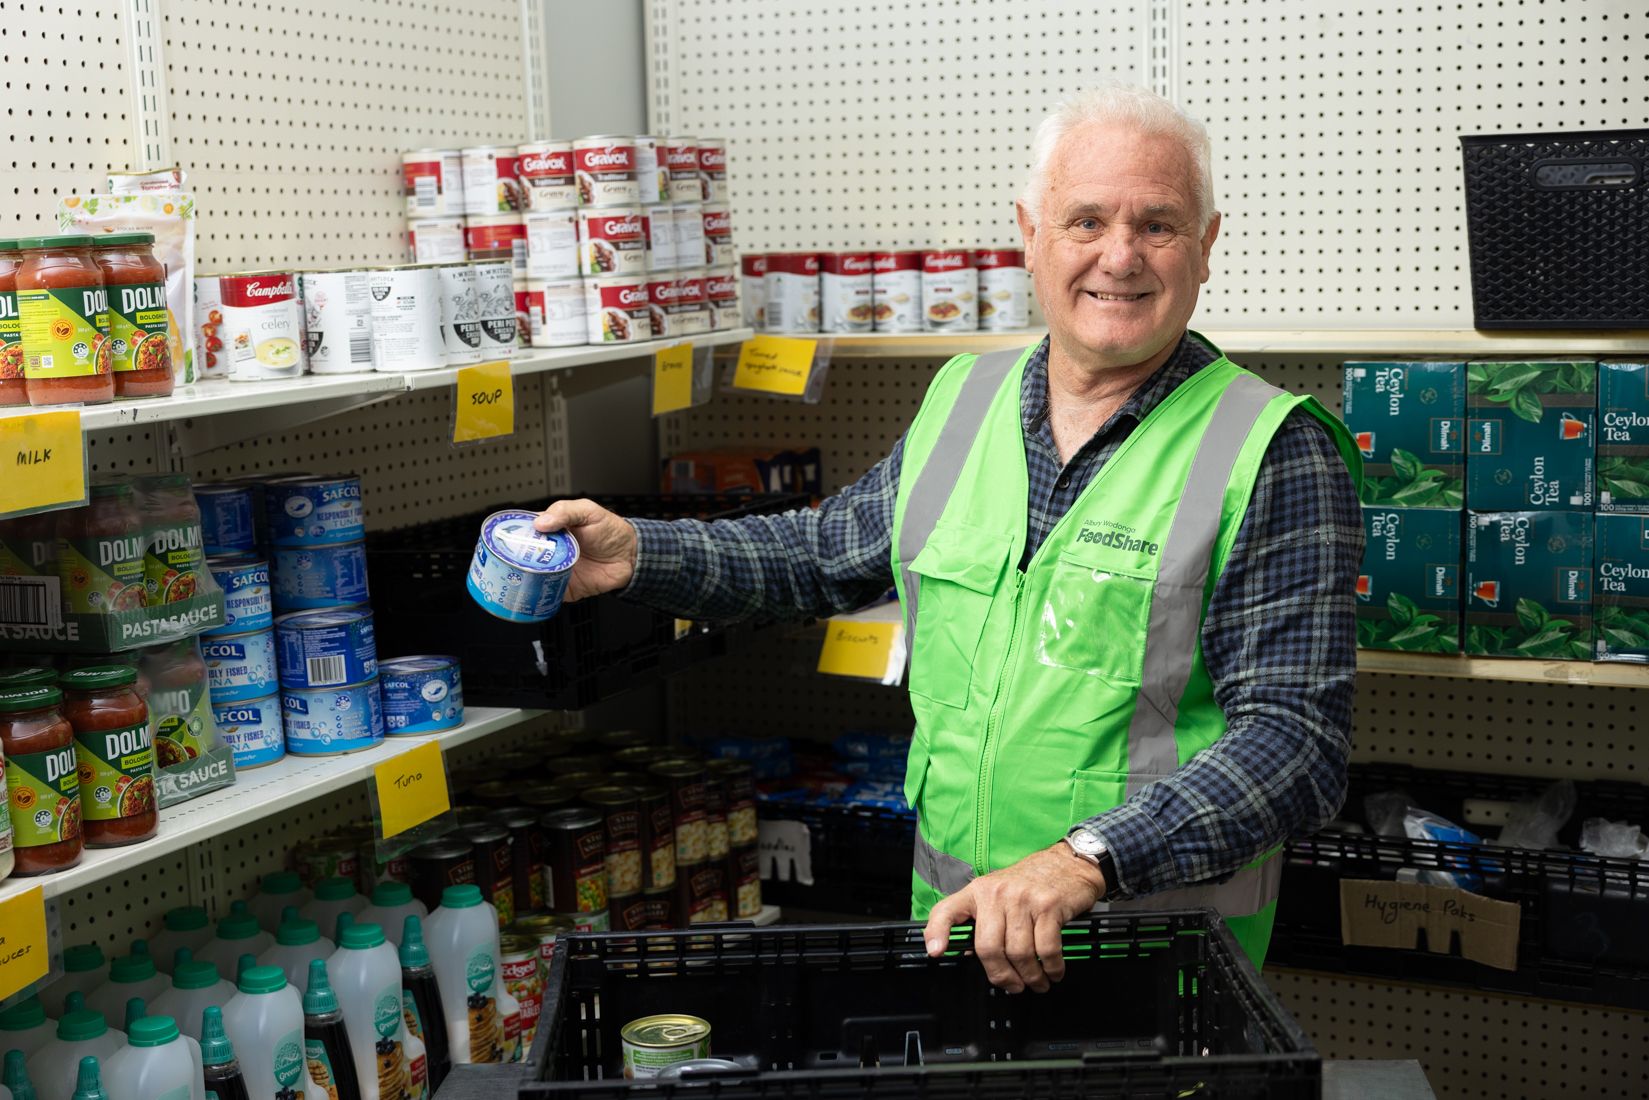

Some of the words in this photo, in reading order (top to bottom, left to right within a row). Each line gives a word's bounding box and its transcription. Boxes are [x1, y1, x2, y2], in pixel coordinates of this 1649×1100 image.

[523, 156, 567, 172] Gravox
[584, 150, 629, 167] Gravox
[604, 219, 641, 235] Gravo
[83, 289, 108, 317] DOL
[121, 286, 167, 314] DOLM
[1345, 367, 1353, 381] 100
[1375, 367, 1390, 394] Tea
[472, 388, 503, 405] SOUP
[1386, 367, 1405, 416] Ceylon
[1440, 420, 1451, 450] Dilmah
[1481, 422, 1492, 452] Dilmah
[1603, 427, 1632, 441] Tea
[16, 448, 52, 466] MILK
[1529, 455, 1548, 506] Ceylon
[322, 486, 360, 502] SAFCOL
[1545, 480, 1560, 506] Tea
[1583, 492, 1592, 506] 100
[1103, 520, 1136, 533] Wodonga
[1372, 512, 1385, 537] Tea
[1469, 515, 1477, 529] 100
[1500, 516, 1514, 542] Tea
[155, 525, 201, 555] DOLM
[1076, 528, 1159, 556] FoodShare
[1383, 513, 1400, 560] Ceylon
[1512, 516, 1530, 566] Ceylon
[99, 536, 145, 567] DOLM
[232, 571, 270, 589] SAFCOL
[1600, 562, 1649, 580] Ceylon
[1435, 566, 1446, 596] Dilmah
[1568, 570, 1578, 600] Dilmah
[1600, 577, 1627, 591] Tea
[243, 603, 268, 616] TUNA
[122, 618, 170, 639] PASTA
[169, 604, 218, 628] SAUCE
[202, 645, 243, 657] FCOL
[226, 666, 248, 677] FISHED
[384, 681, 411, 689] SAFCOL
[283, 697, 307, 712] COL
[215, 709, 260, 723] AFCOL
[105, 724, 151, 760] DOLM
[243, 729, 264, 742] FISHED
[46, 747, 77, 782] DOL
[179, 759, 228, 789] SAUCE
[394, 772, 423, 789] Tuna
[1363, 893, 1431, 924] Hygiene
[1443, 900, 1476, 923] Paks
[502, 959, 537, 978] Edgell
[520, 1004, 541, 1018] TABLES
